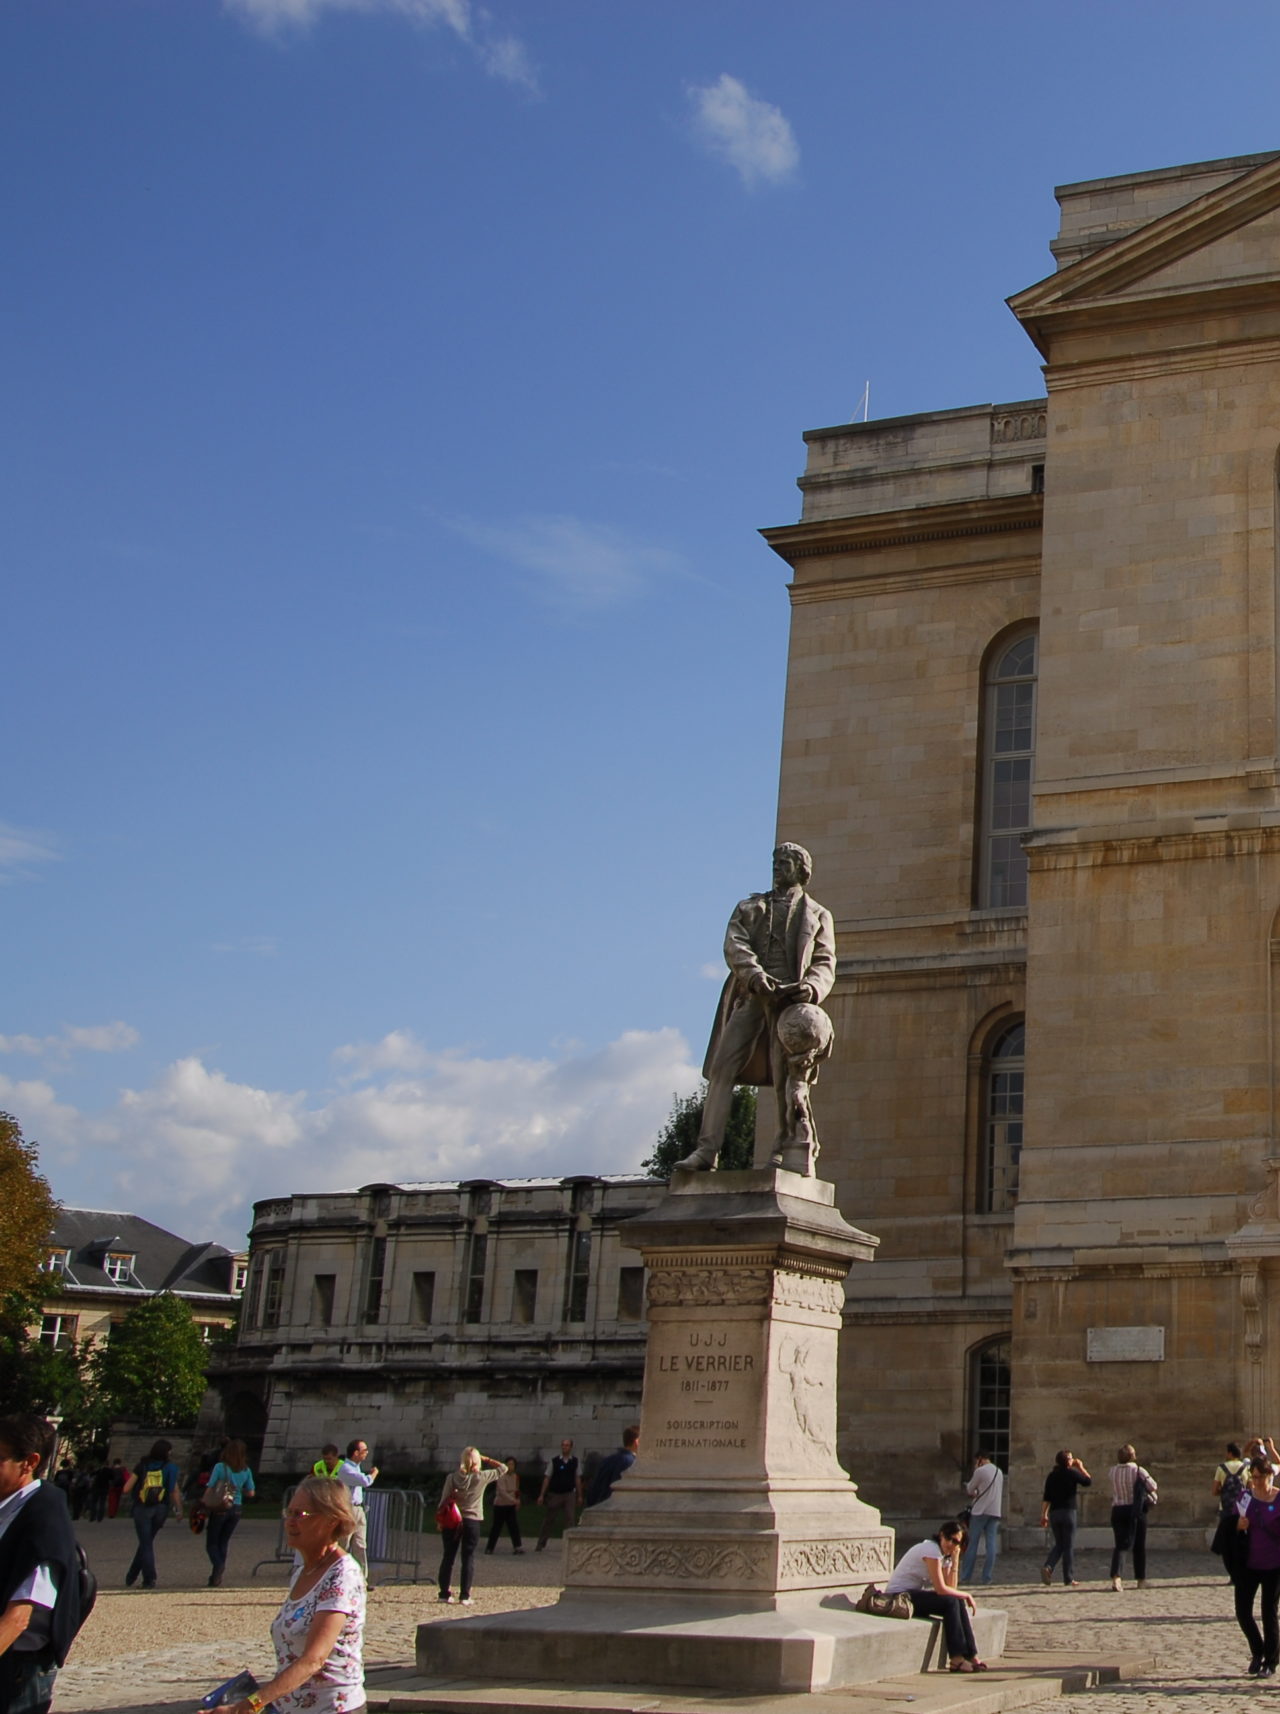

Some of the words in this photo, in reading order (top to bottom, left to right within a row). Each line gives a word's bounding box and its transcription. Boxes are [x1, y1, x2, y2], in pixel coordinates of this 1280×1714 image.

[659, 1355, 680, 1372] LE
[684, 1354, 754, 1372] VERRIER
[681, 1379, 730, 1392] 1811-1877
[666, 1420, 740, 1430] SOUSCRIPTION
[655, 1438, 747, 1449] INTERNATIONALE
